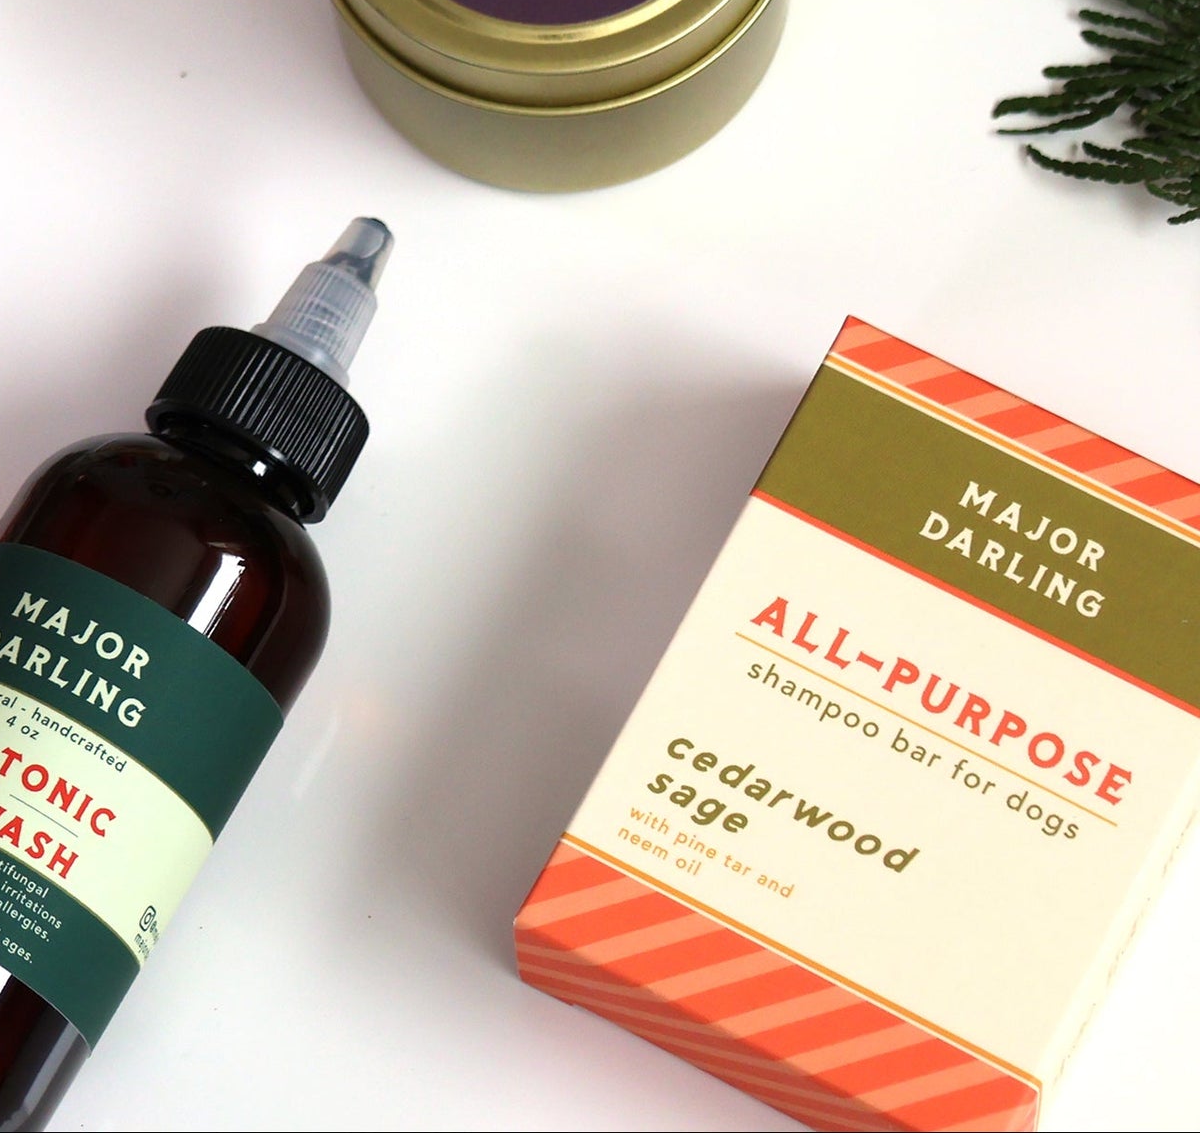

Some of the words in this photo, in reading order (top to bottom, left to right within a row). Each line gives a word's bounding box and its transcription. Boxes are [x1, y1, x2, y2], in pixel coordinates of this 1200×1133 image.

[919, 510, 1106, 619] DARLING
[958, 480, 1106, 572] MAJOR
[12, 591, 151, 679] MAJOR
[5, 715, 15, 728] 4
[20, 725, 40, 740] oz
[31, 707, 127, 773] handcrafted
[749, 595, 1133, 807] ALL-PURPOSE
[747, 660, 880, 739] shampoo
[890, 728, 942, 766] bar
[950, 758, 997, 795] for
[1005, 789, 1080, 840] dogs
[647, 771, 749, 834] sage
[666, 737, 921, 873] cedarwood
[618, 827, 669, 861] neem
[675, 856, 702, 876] oil
[629, 807, 670, 835] with
[673, 830, 717, 859] pine
[723, 854, 752, 876] tar
[757, 873, 795, 898] and
[1, 882, 63, 929] irritations
[1, 937, 34, 964] ages.
